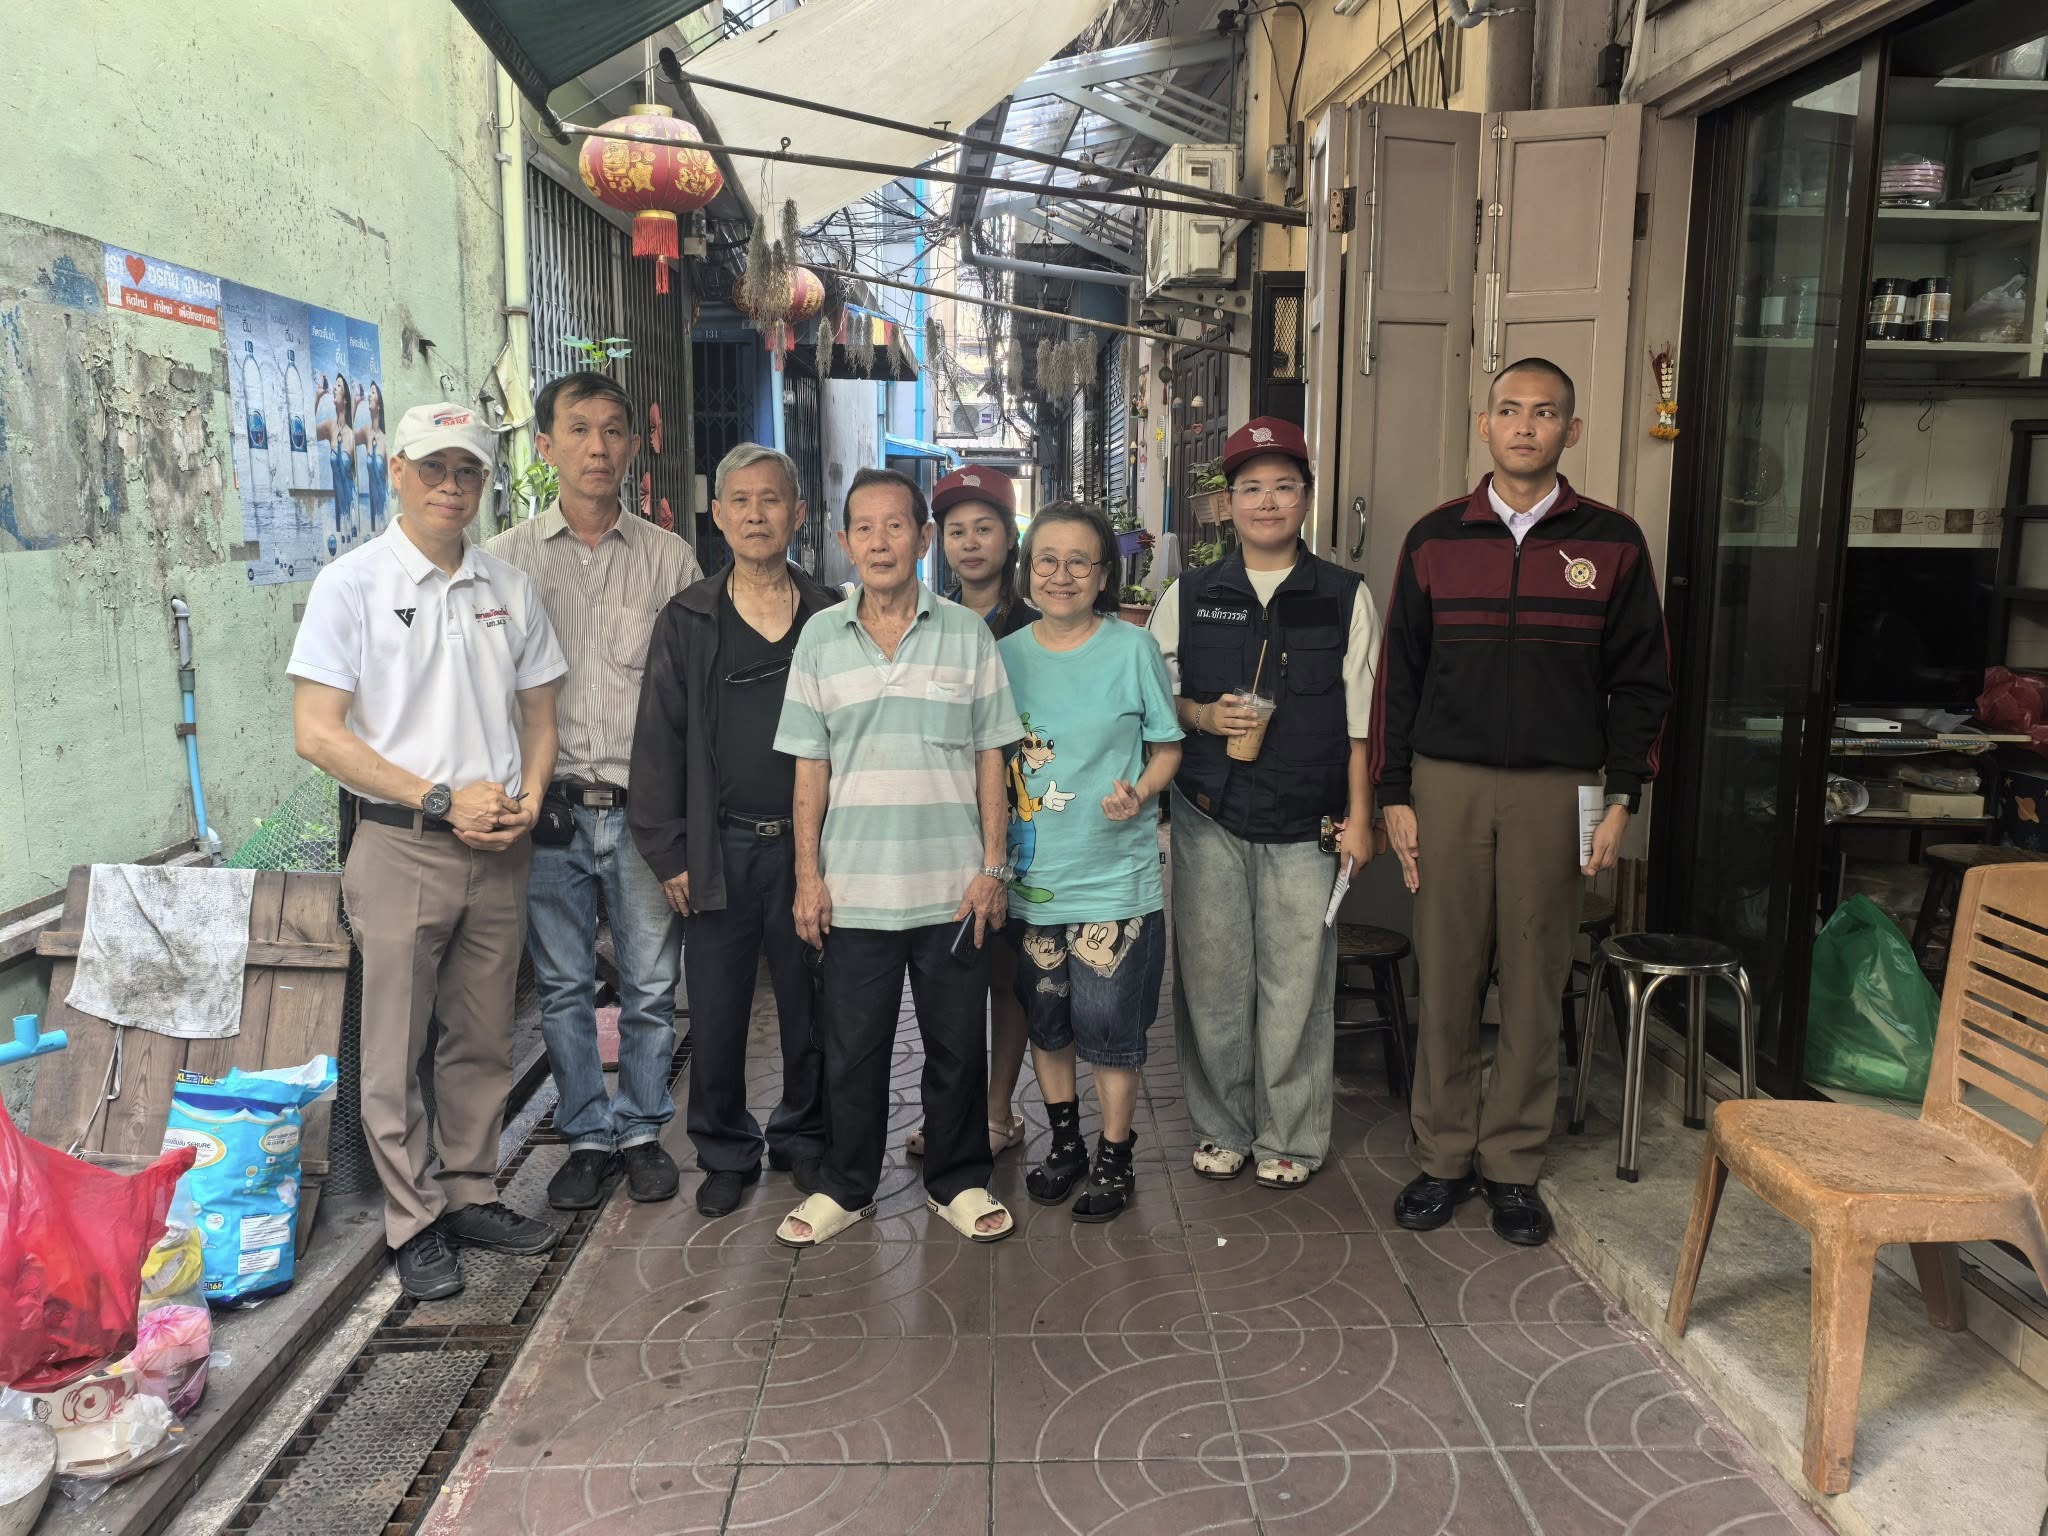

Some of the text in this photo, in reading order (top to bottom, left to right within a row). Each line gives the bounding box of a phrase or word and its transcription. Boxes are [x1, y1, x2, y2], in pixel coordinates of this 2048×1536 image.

[1196, 607, 1248, 621] สน.จักรวรรดิ
